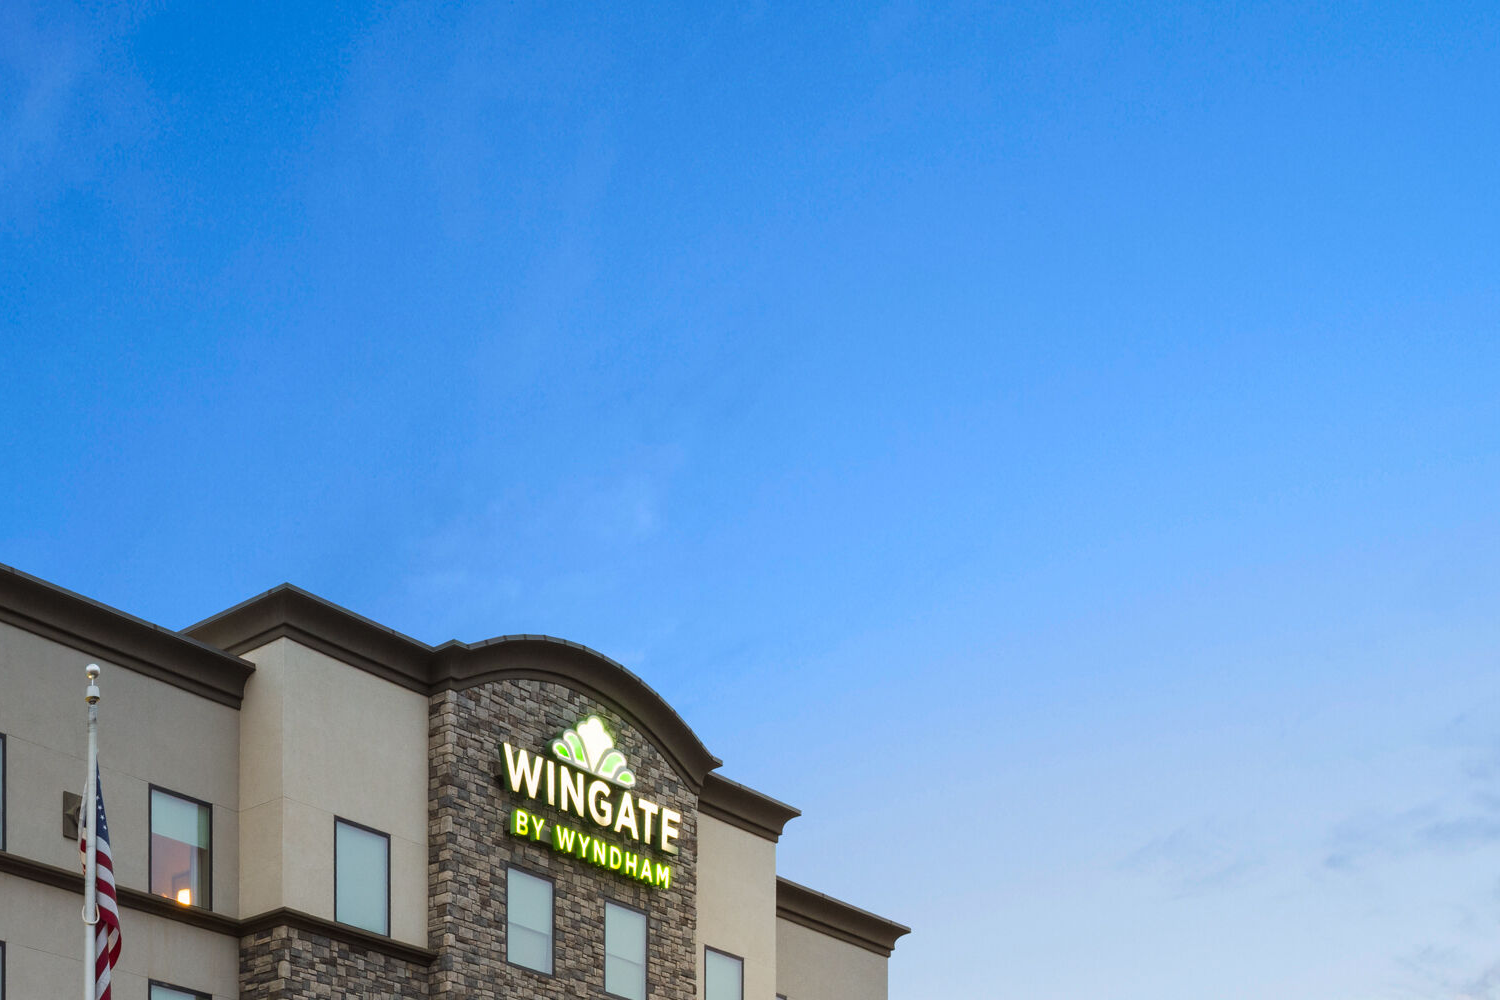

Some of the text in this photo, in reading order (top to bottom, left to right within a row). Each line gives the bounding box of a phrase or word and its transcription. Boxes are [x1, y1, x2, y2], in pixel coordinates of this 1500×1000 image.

[503, 742, 681, 856] WINGATE
[514, 809, 670, 889] BY WYNDHAM
